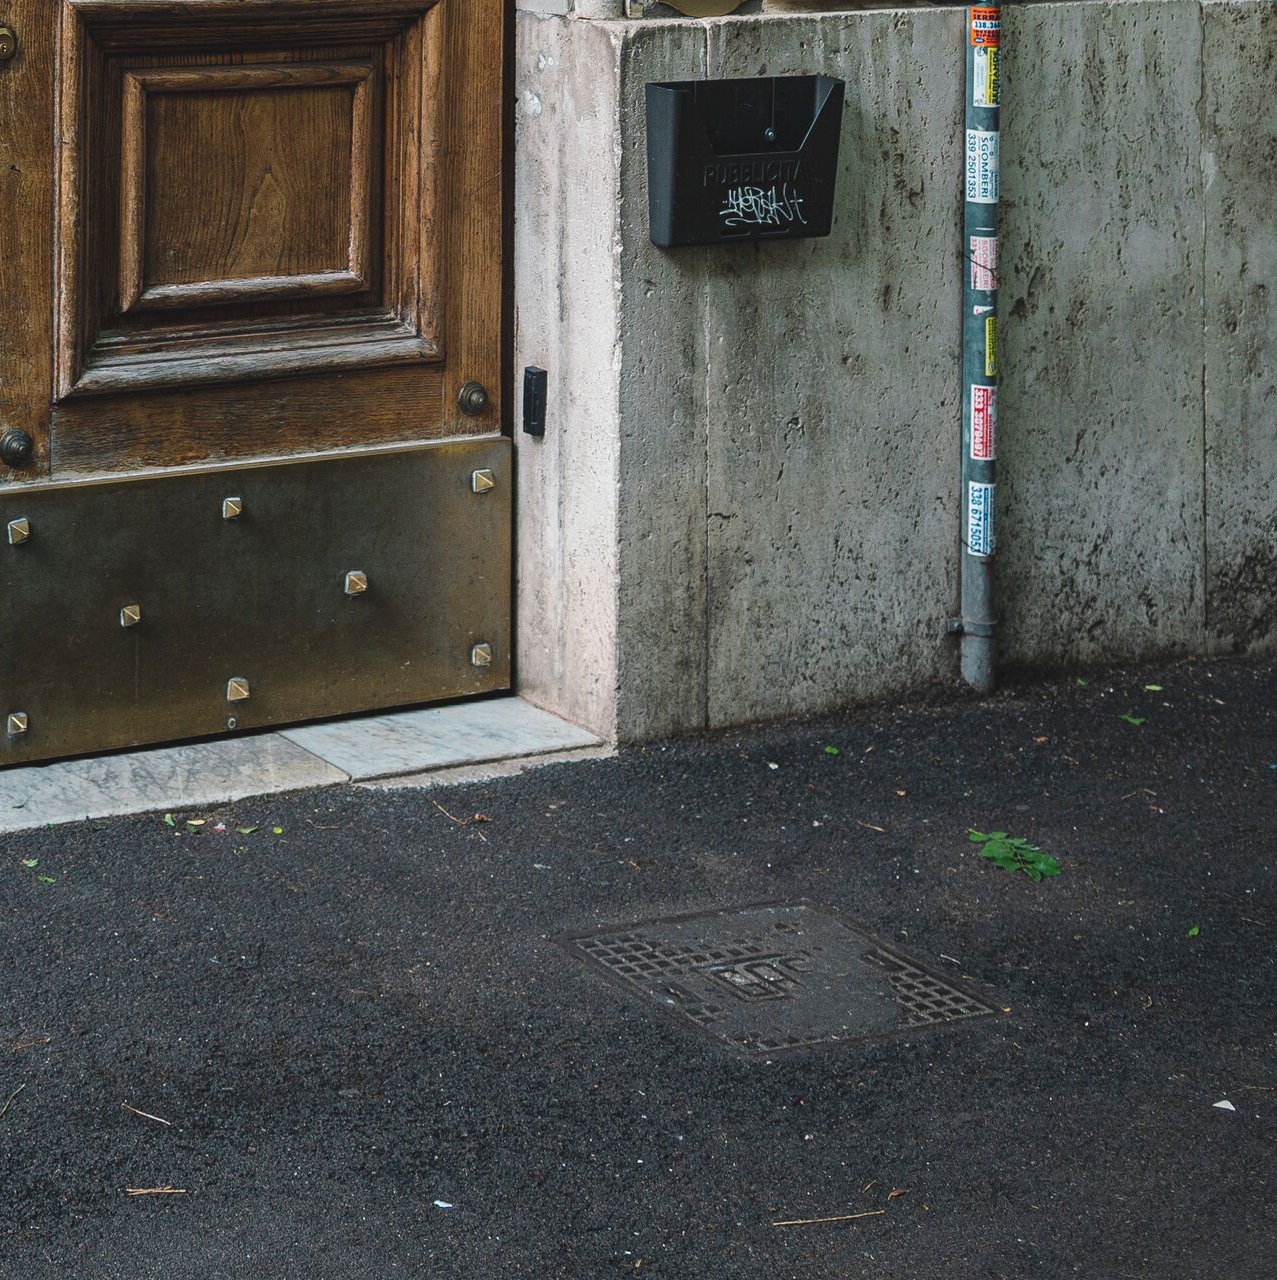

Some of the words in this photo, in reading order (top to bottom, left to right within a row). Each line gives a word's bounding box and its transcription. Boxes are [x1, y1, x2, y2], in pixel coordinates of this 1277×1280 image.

[968, 133, 976, 153] 339
[967, 155, 977, 199] 2501353
[981, 136, 989, 198] SGOMBERI
[975, 388, 984, 409] 333
[971, 486, 982, 506] 338
